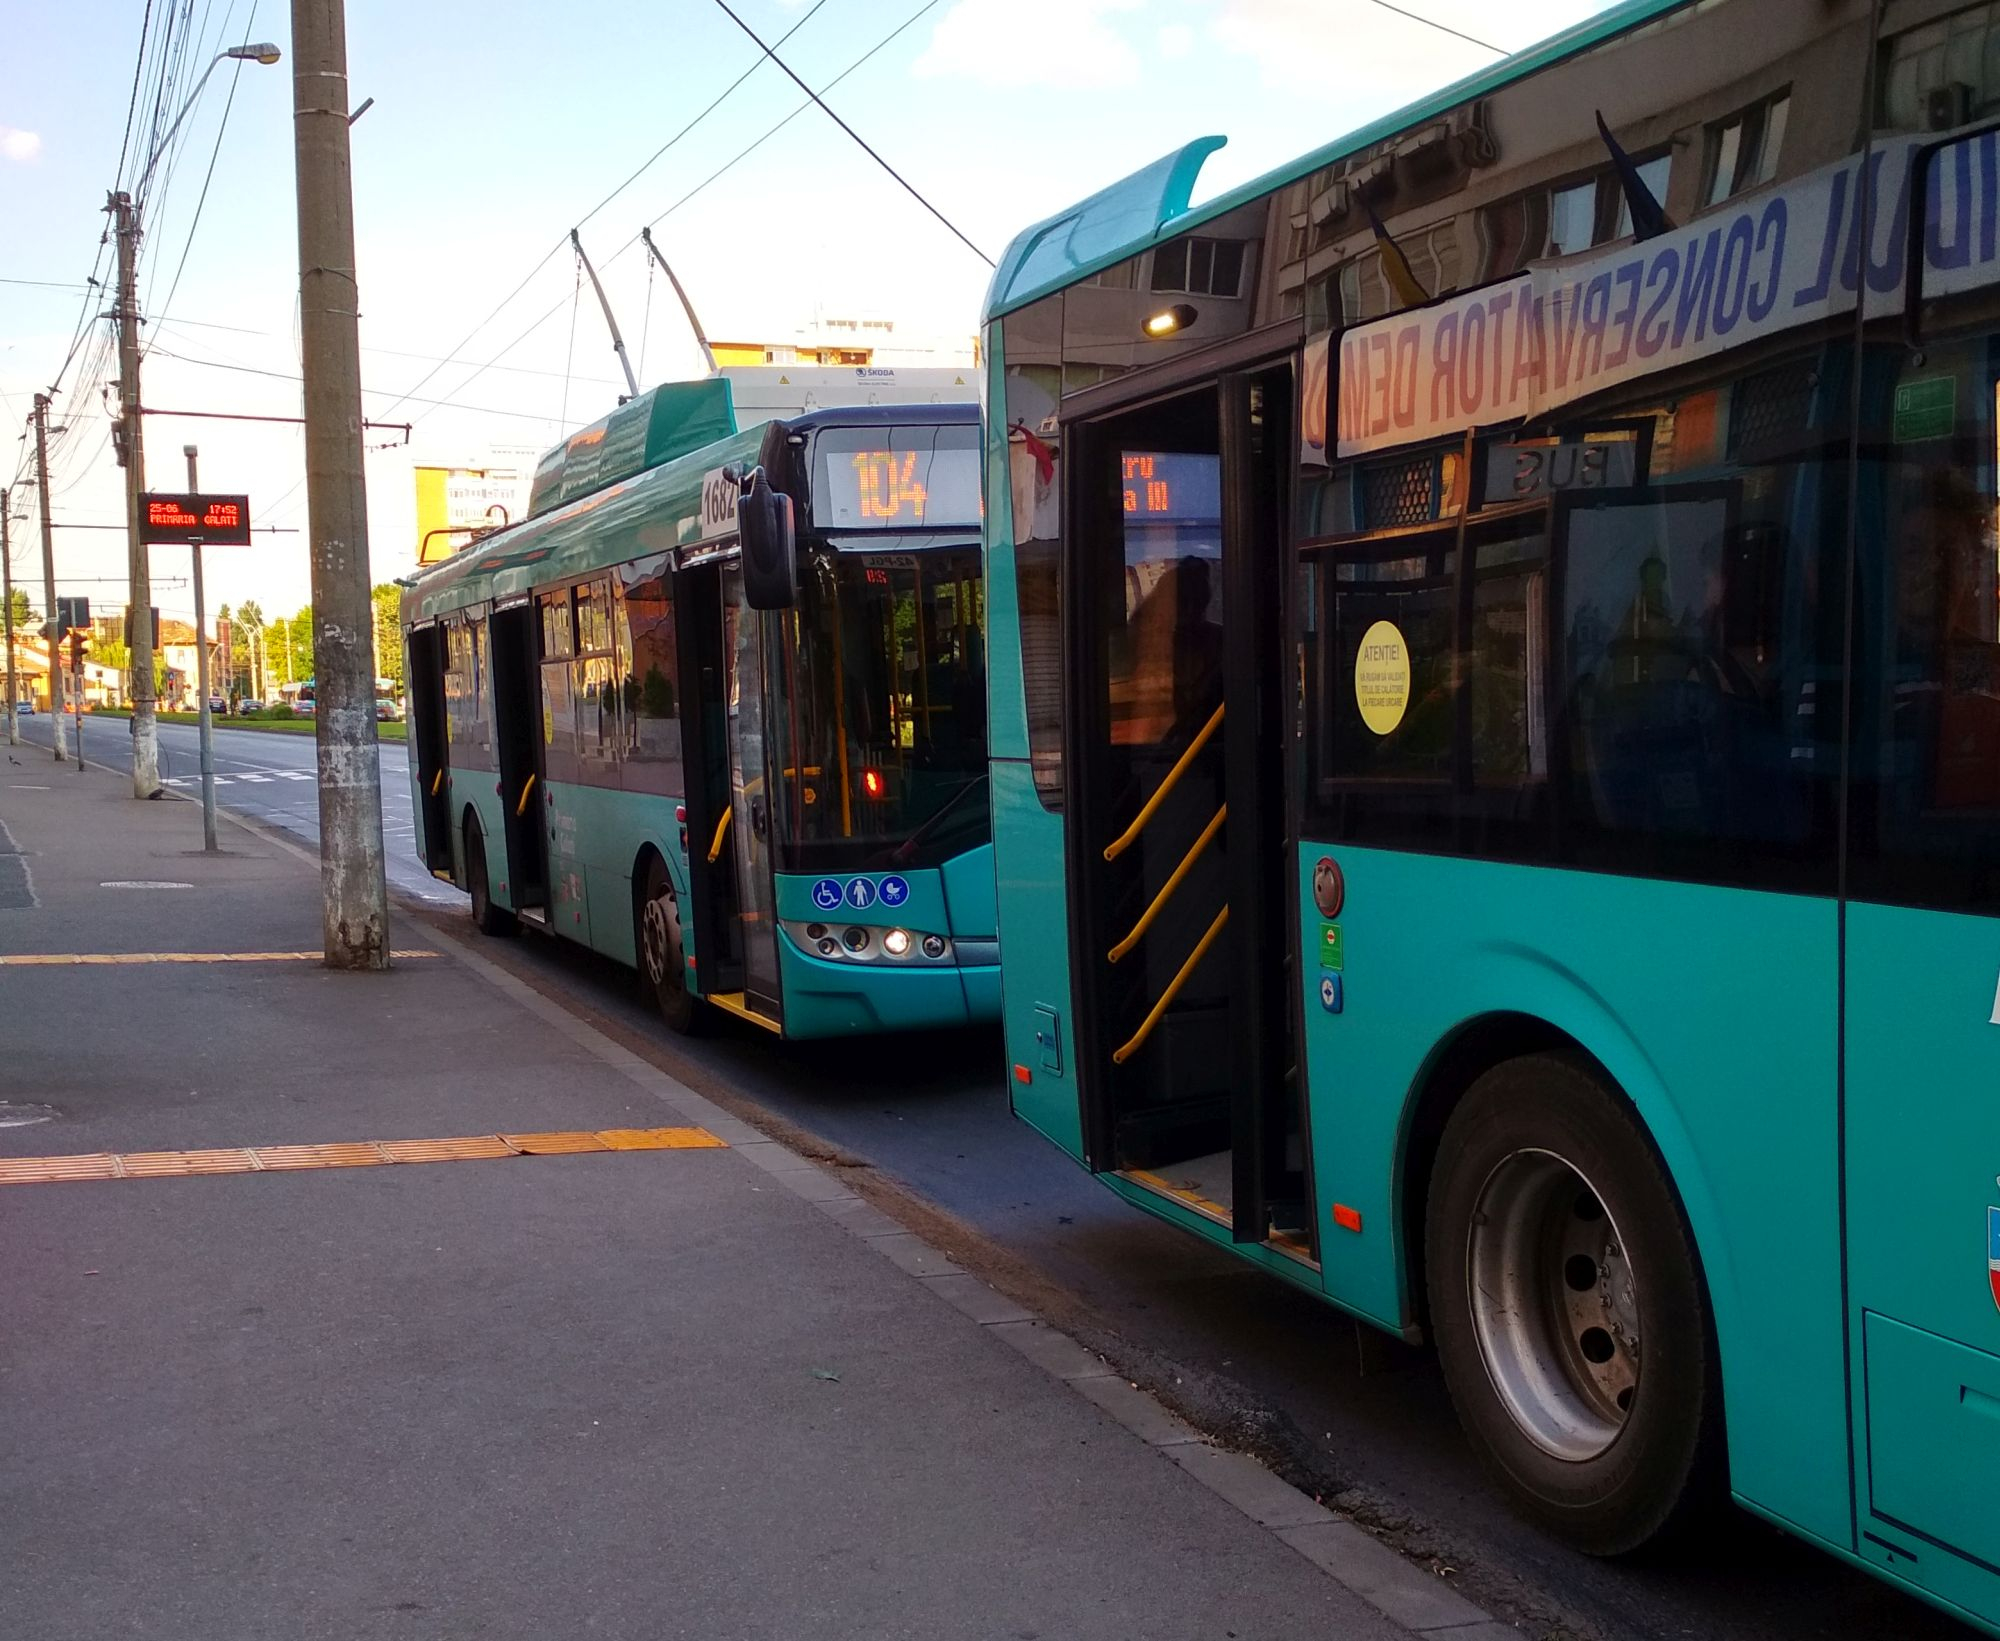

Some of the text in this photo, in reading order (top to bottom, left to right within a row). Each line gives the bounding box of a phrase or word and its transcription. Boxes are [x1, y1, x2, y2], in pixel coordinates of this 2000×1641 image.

[852, 451, 928, 517] 104
[149, 503, 238, 515] 25-06 17:52
[704, 479, 735, 526] 1682
[149, 514, 238, 527] PRIMARIA GALATI
